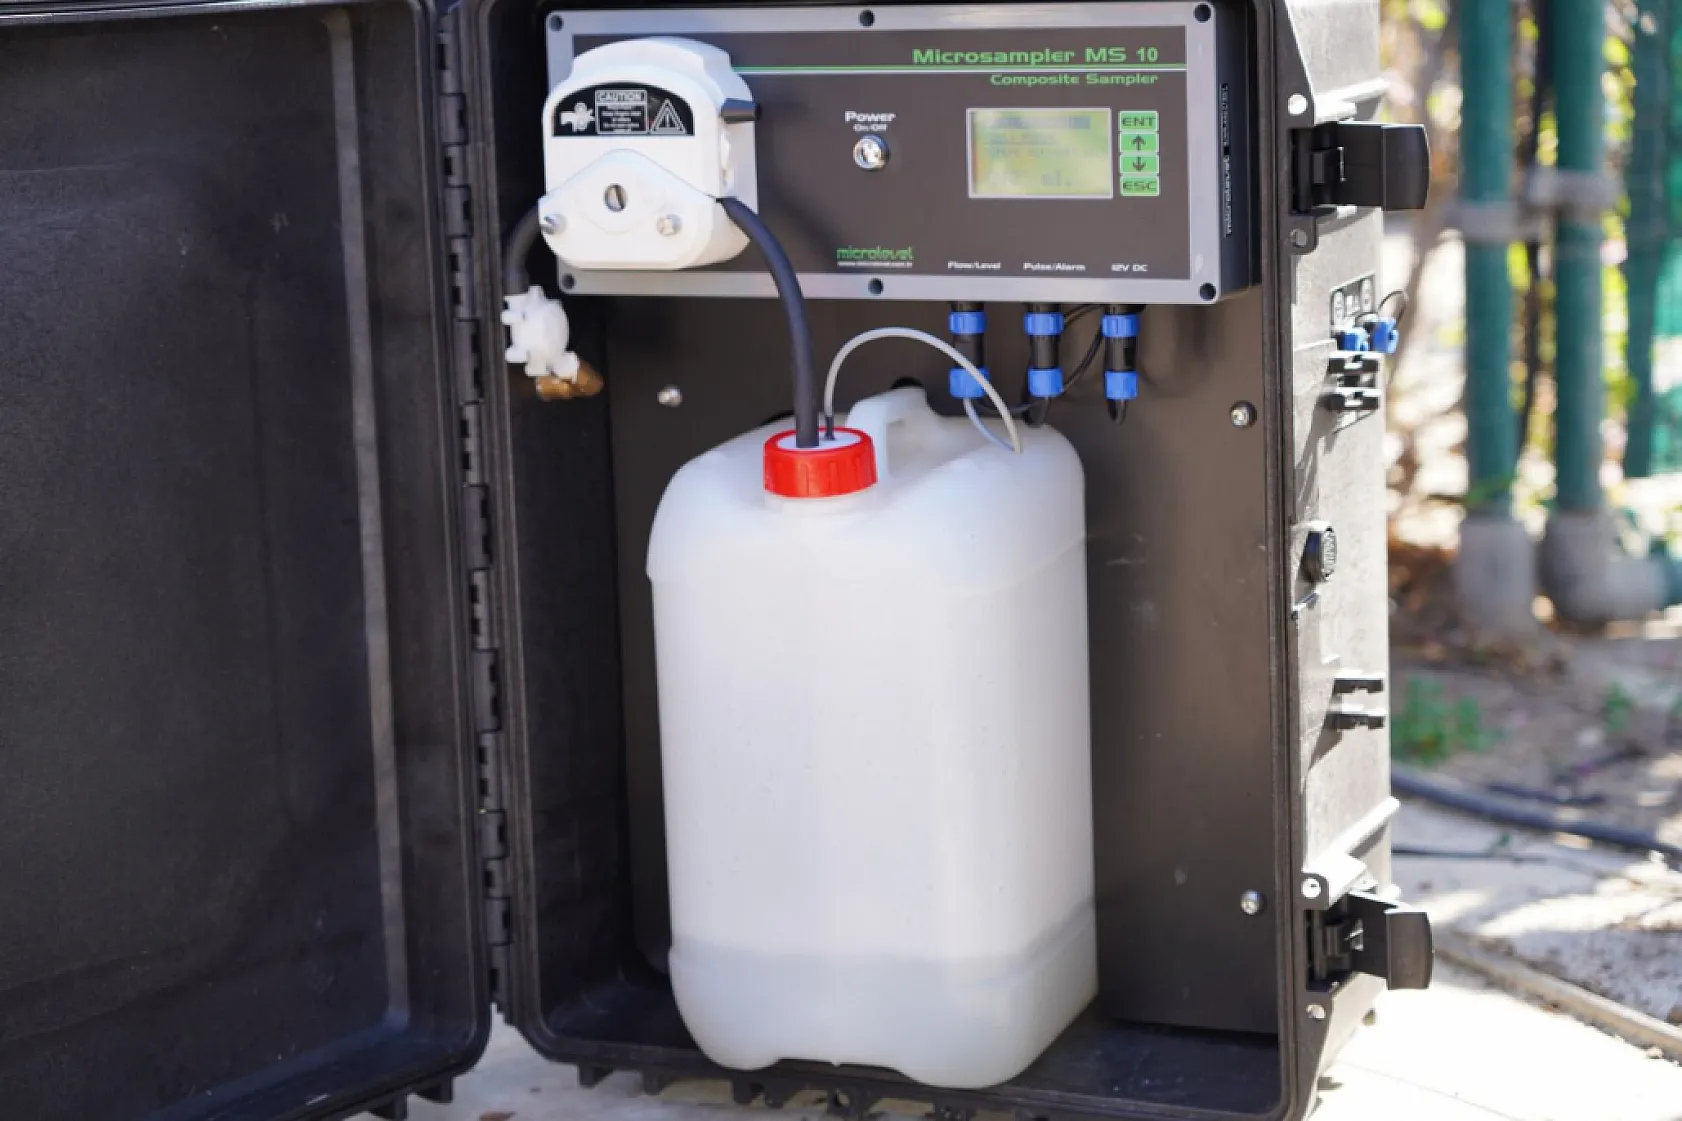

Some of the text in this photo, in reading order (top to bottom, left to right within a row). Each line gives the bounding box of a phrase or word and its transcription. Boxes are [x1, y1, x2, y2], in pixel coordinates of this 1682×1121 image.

[912, 47, 1159, 65] Microsampler MS 10
[990, 73, 1159, 87] Composite Sampler
[597, 91, 645, 102] CAUTION
[844, 110, 897, 123] Power
[1121, 116, 1156, 128] ENT
[1122, 180, 1157, 192] ESC
[1023, 261, 1086, 272] Pulse/Alarm
[1132, 263, 1149, 272] DC
